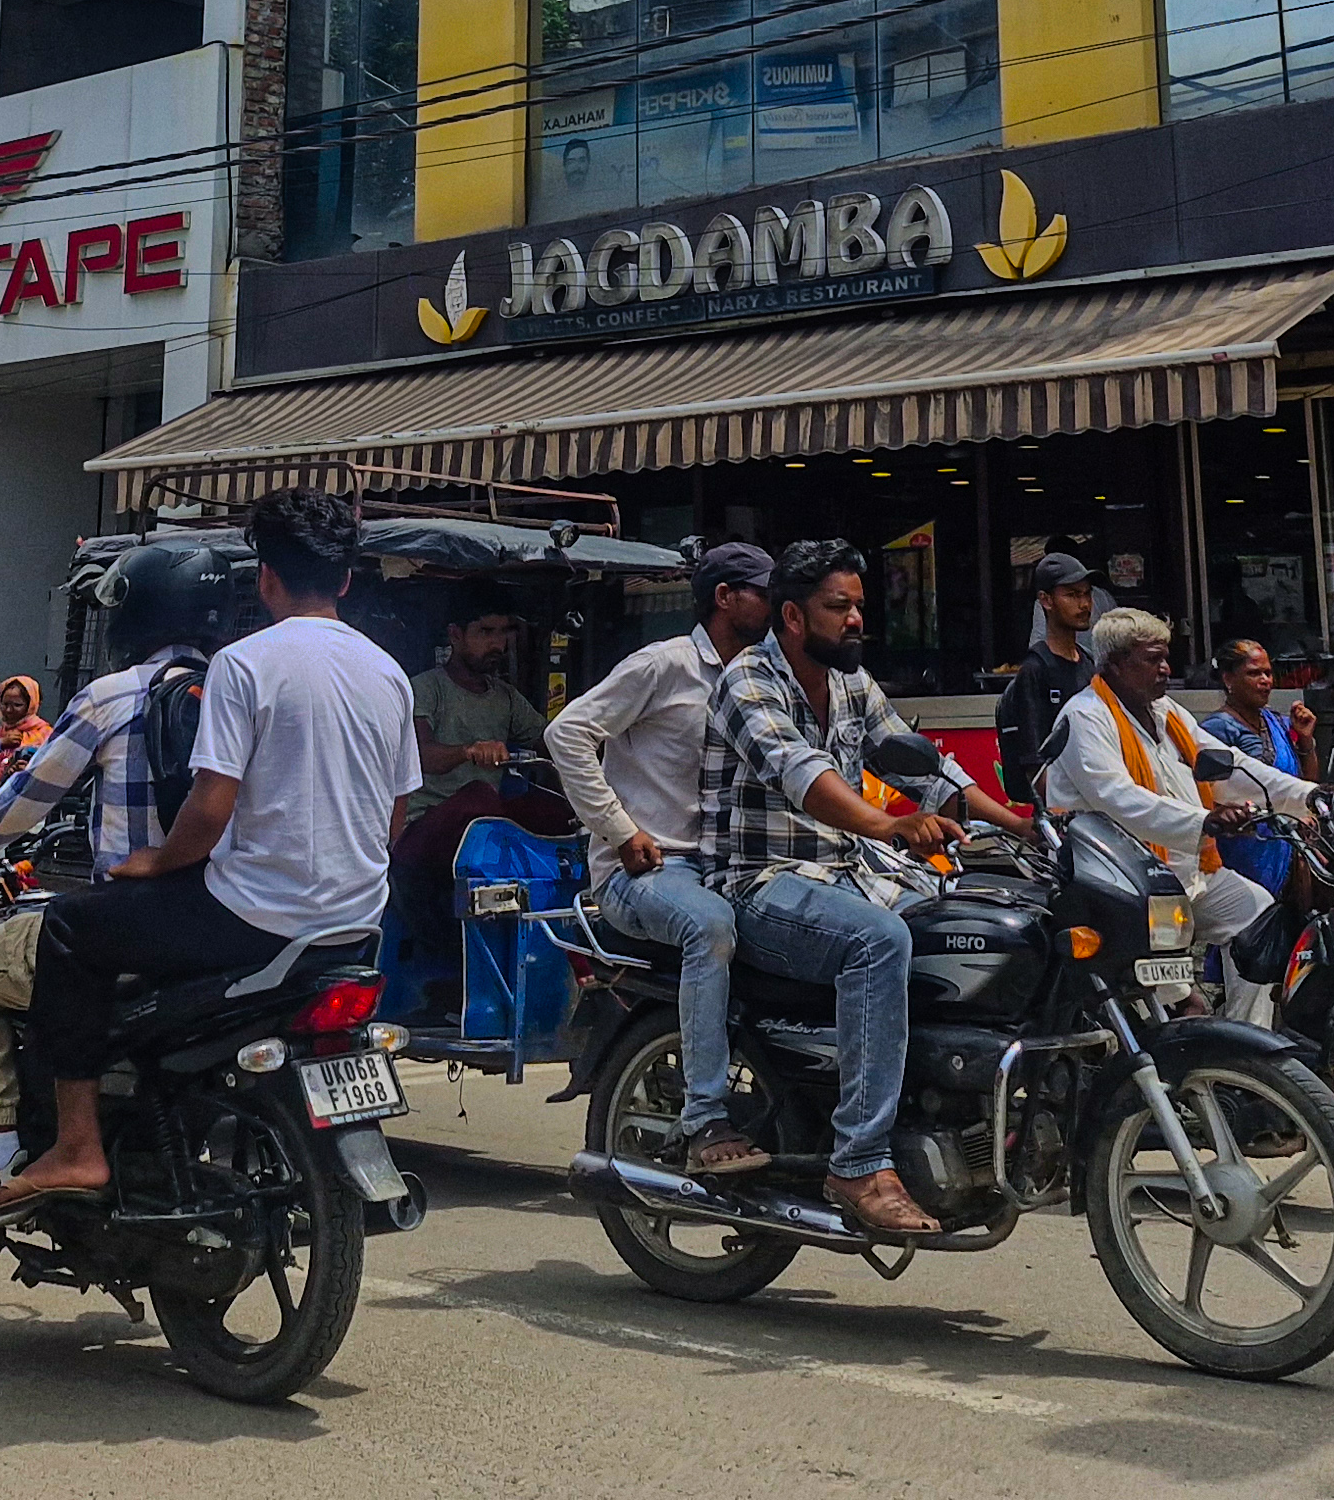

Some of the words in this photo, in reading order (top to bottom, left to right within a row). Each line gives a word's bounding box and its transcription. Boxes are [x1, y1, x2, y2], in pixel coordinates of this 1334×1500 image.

[499, 183, 955, 320] JAGDAMBA
[786, 273, 925, 306] RESTAURANT
[946, 934, 987, 951] Hero
[319, 1057, 380, 1087] UK06B
[327, 1080, 389, 1112] F1968
